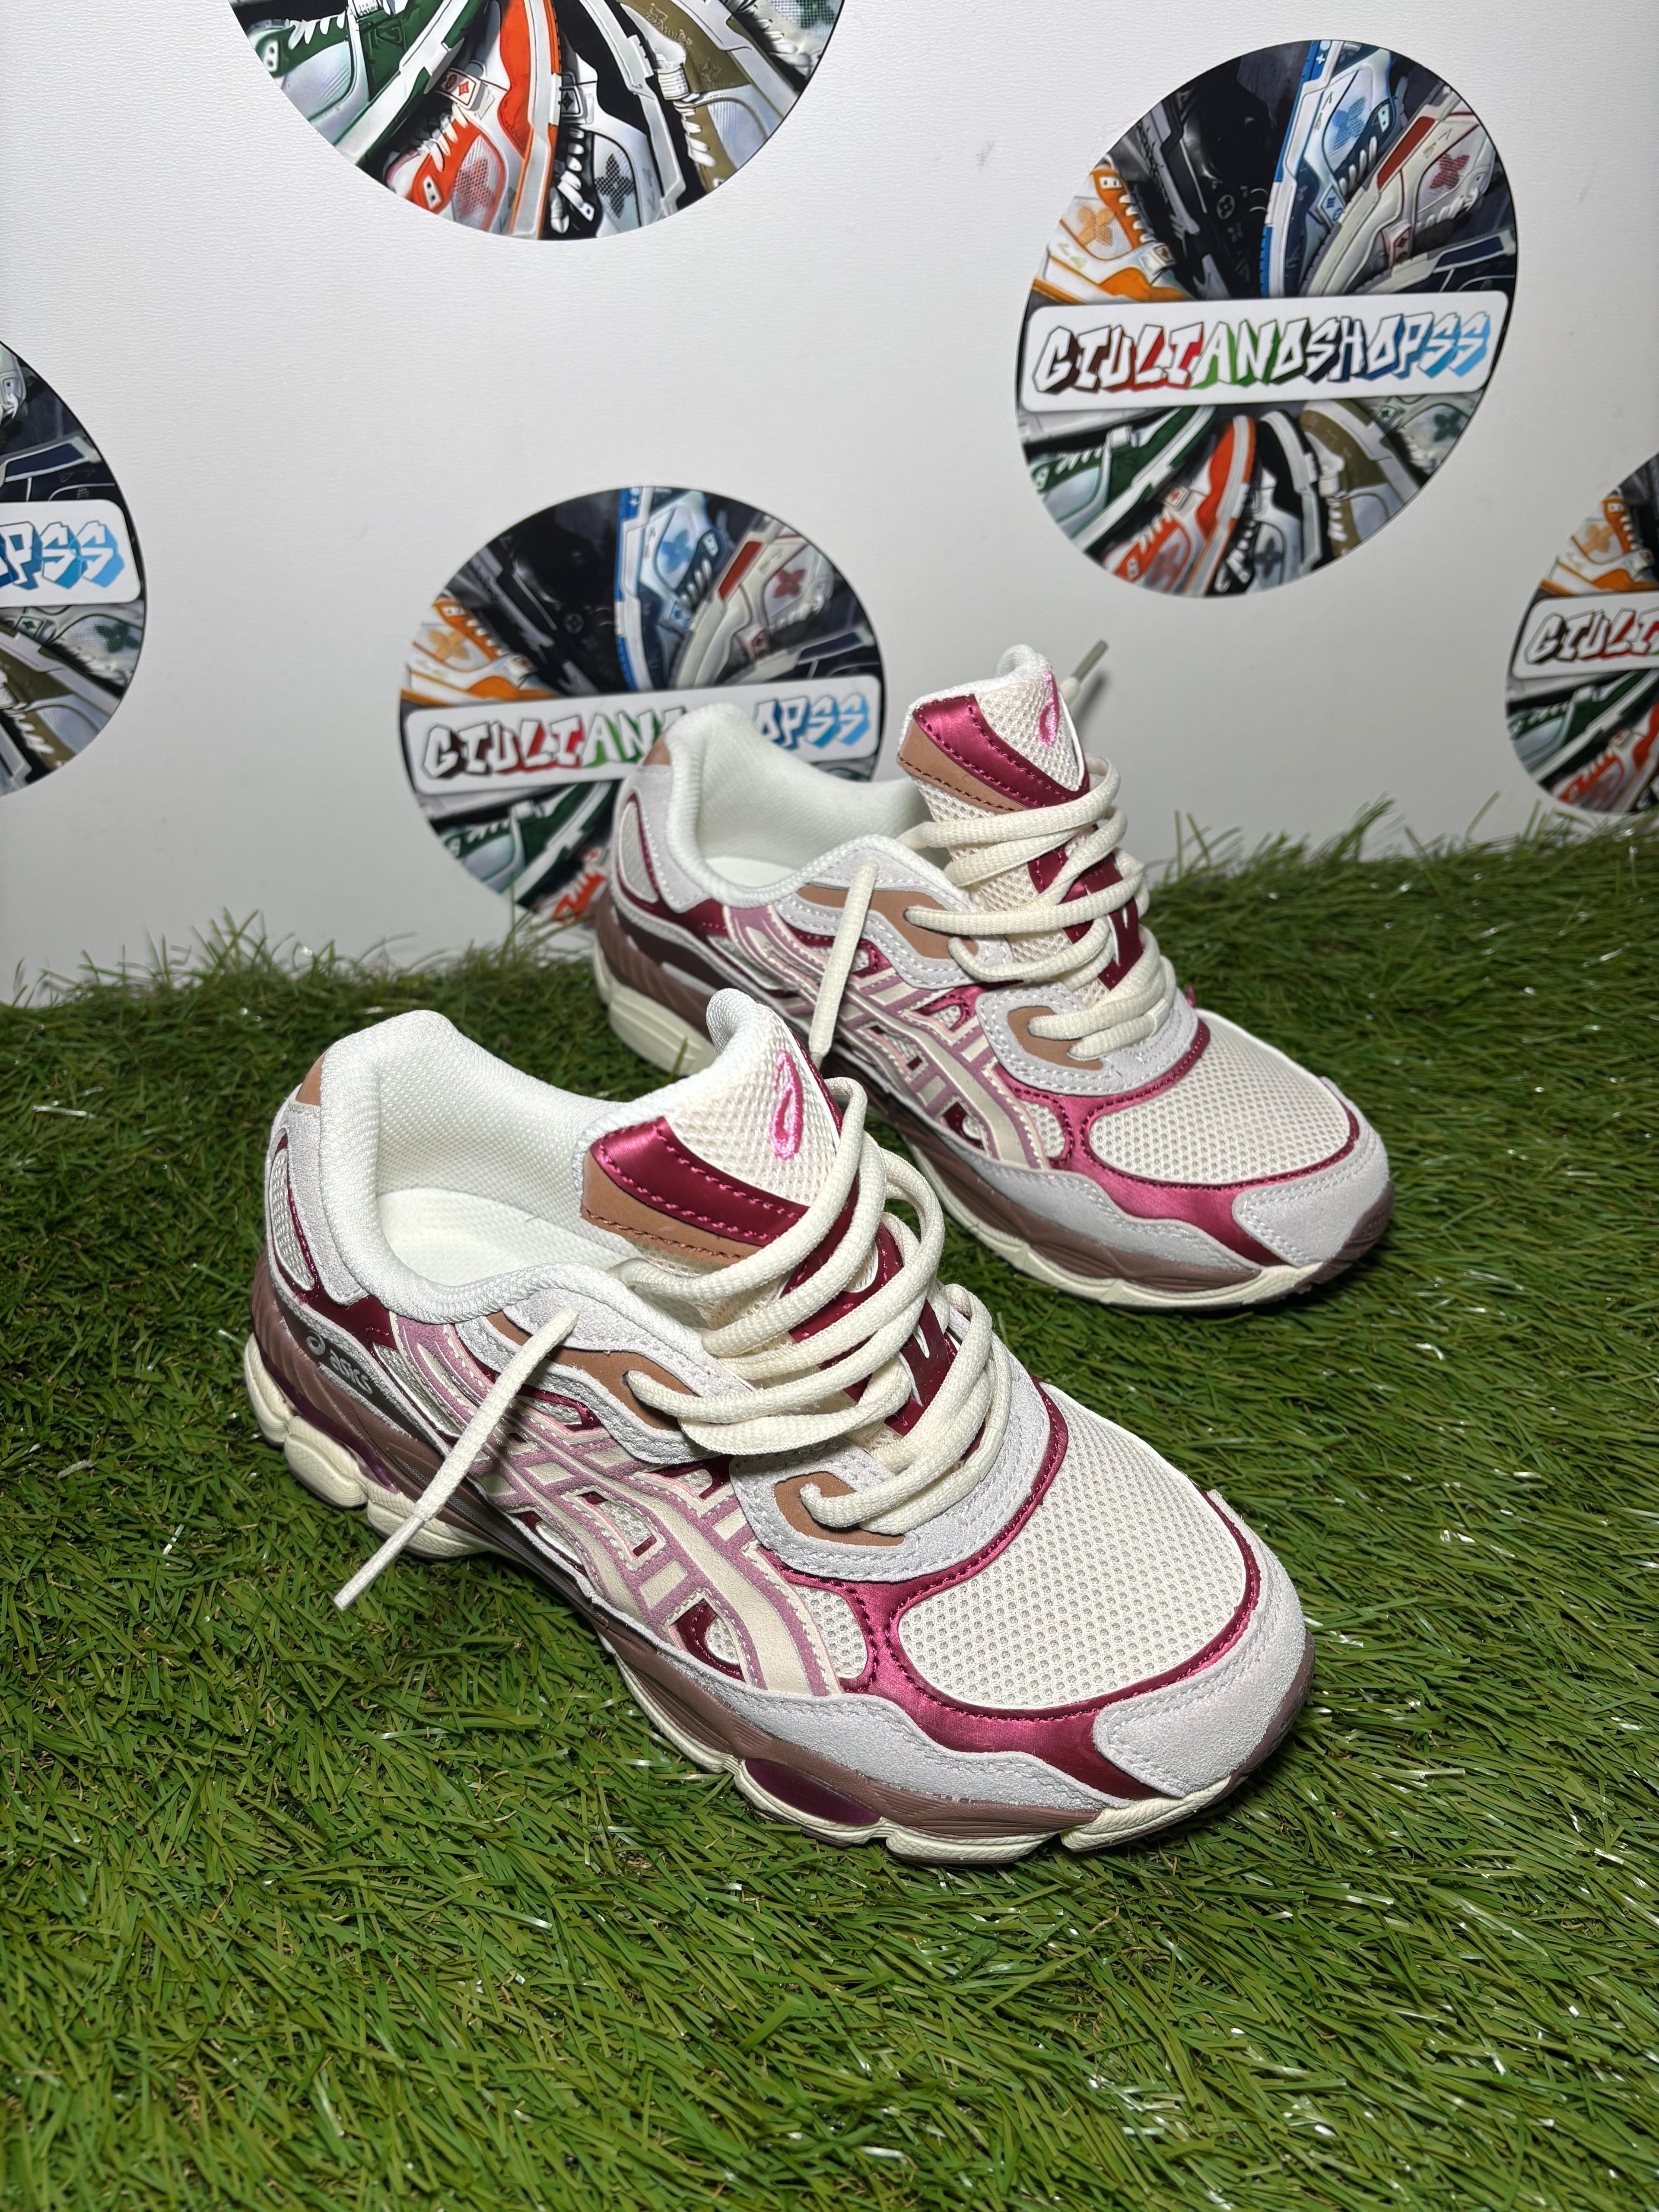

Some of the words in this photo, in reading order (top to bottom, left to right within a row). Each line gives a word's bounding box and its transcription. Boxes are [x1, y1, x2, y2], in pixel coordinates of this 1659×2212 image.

[1033, 311, 1492, 393] GIULIANOSHOPSS
[0, 520, 125, 590] PSS
[1525, 606, 1659, 664] GIULI
[423, 692, 870, 779] GIULIANOPSS
[329, 1349, 373, 1394] asics
